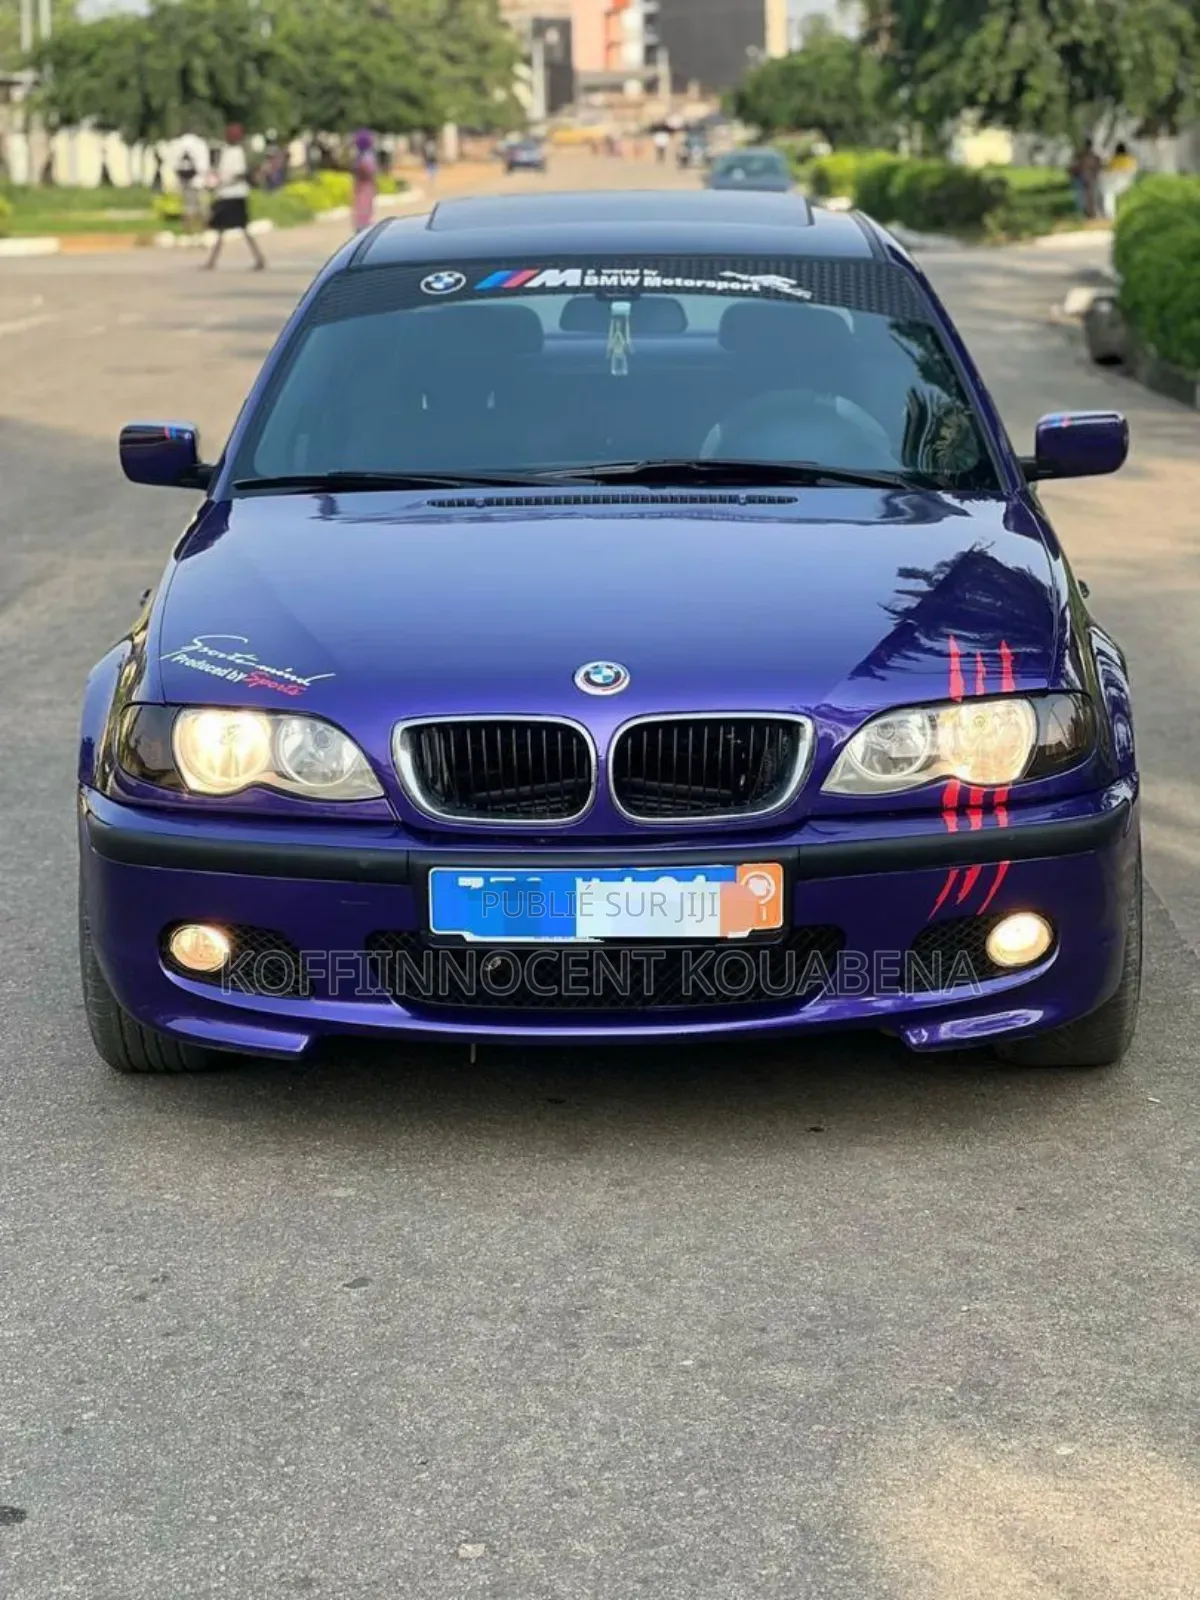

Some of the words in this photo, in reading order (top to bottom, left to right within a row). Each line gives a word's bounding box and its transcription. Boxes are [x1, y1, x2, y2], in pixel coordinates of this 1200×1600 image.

[583, 275, 640, 287] BMW
[643, 276, 760, 291] Motorsport
[171, 653, 233, 678] Produced
